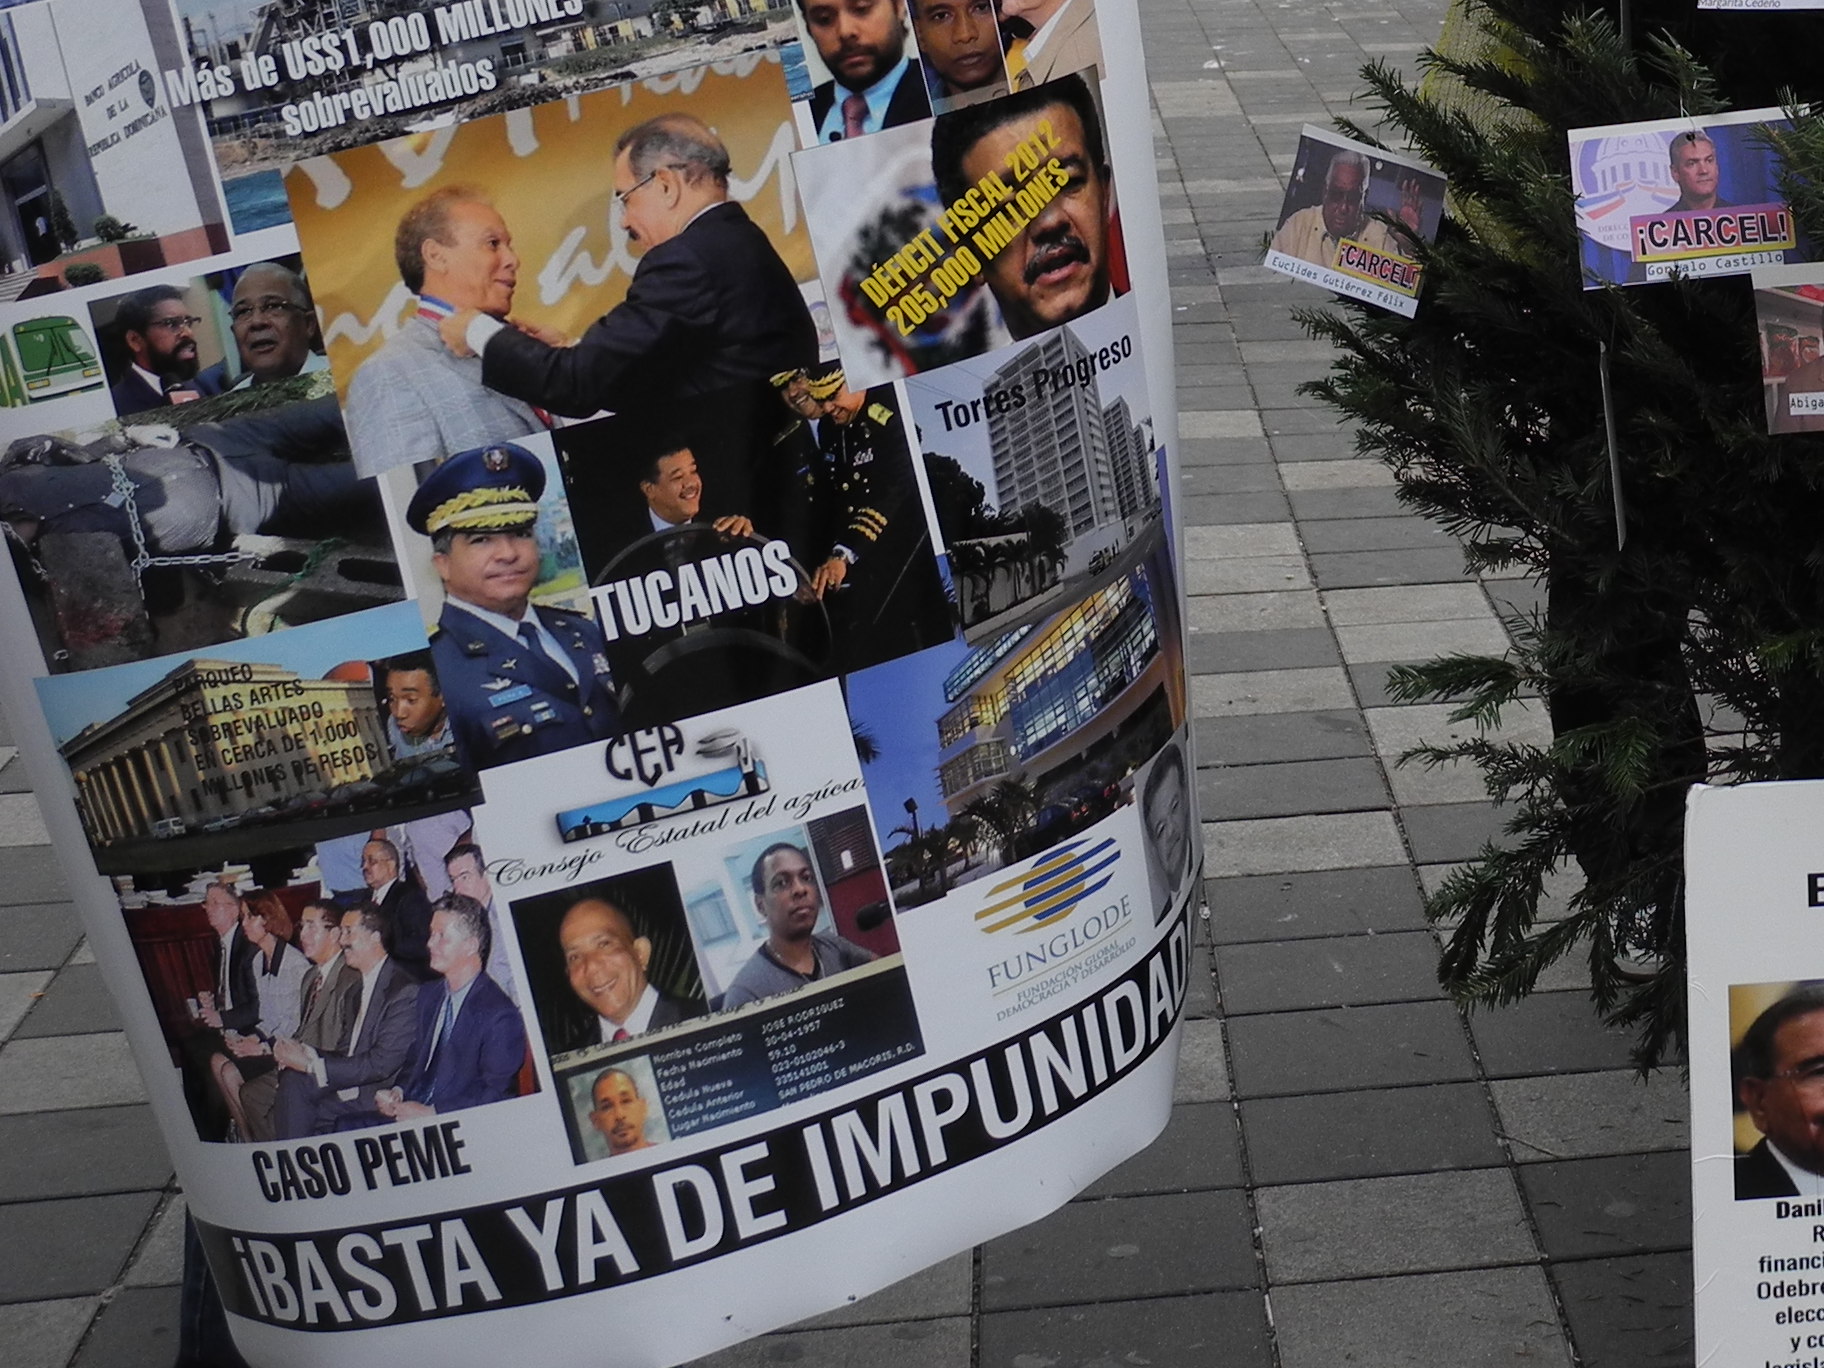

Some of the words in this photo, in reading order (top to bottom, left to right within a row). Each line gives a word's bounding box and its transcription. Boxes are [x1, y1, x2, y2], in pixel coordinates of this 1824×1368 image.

[164, 60, 235, 109] Más
[242, 51, 279, 89] de
[283, 11, 432, 84] US$1,000
[280, 55, 498, 137] sobrevaluados
[859, 233, 947, 309] DÉFICIT
[938, 171, 1015, 247] FISCAL
[1005, 119, 1062, 184] 2012
[885, 244, 981, 337] 205,000
[975, 157, 1070, 262] MILLONES
[1638, 211, 1789, 255] ¡CARCEL!
[1272, 257, 1318, 280] Euclides
[1323, 273, 1373, 298] Gutiérrez
[1377, 289, 1405, 309] Félix
[1716, 251, 1784, 269] Castillo
[935, 377, 1026, 433] Torres
[1033, 334, 1132, 404] Progreso
[588, 538, 798, 641] TUCANOS
[180, 694, 243, 721] BELLAS
[250, 679, 304, 707] ARTES
[187, 701, 323, 746] SOBREVALUADO
[221, 738, 277, 766] CERCA
[283, 729, 306, 753] DE
[309, 720, 359, 746] 1,000
[318, 742, 378, 771] PESOS
[484, 845, 605, 889] Consejo
[615, 809, 731, 854] Estatal
[733, 795, 778, 828] del
[987, 894, 1132, 989] FUNGLODE
[996, 981, 1071, 1022] DEMOCRACIA
[1080, 936, 1137, 981] DESARROLLO
[1017, 962, 1083, 1002] FUNDACIÓN
[1084, 940, 1120, 969] GLOBAL
[252, 1142, 352, 1204] CASO
[355, 1120, 472, 1191] PEME
[232, 1218, 503, 1326] ¡BASTA
[504, 1188, 641, 1293] YA
[651, 1140, 788, 1263] DE
